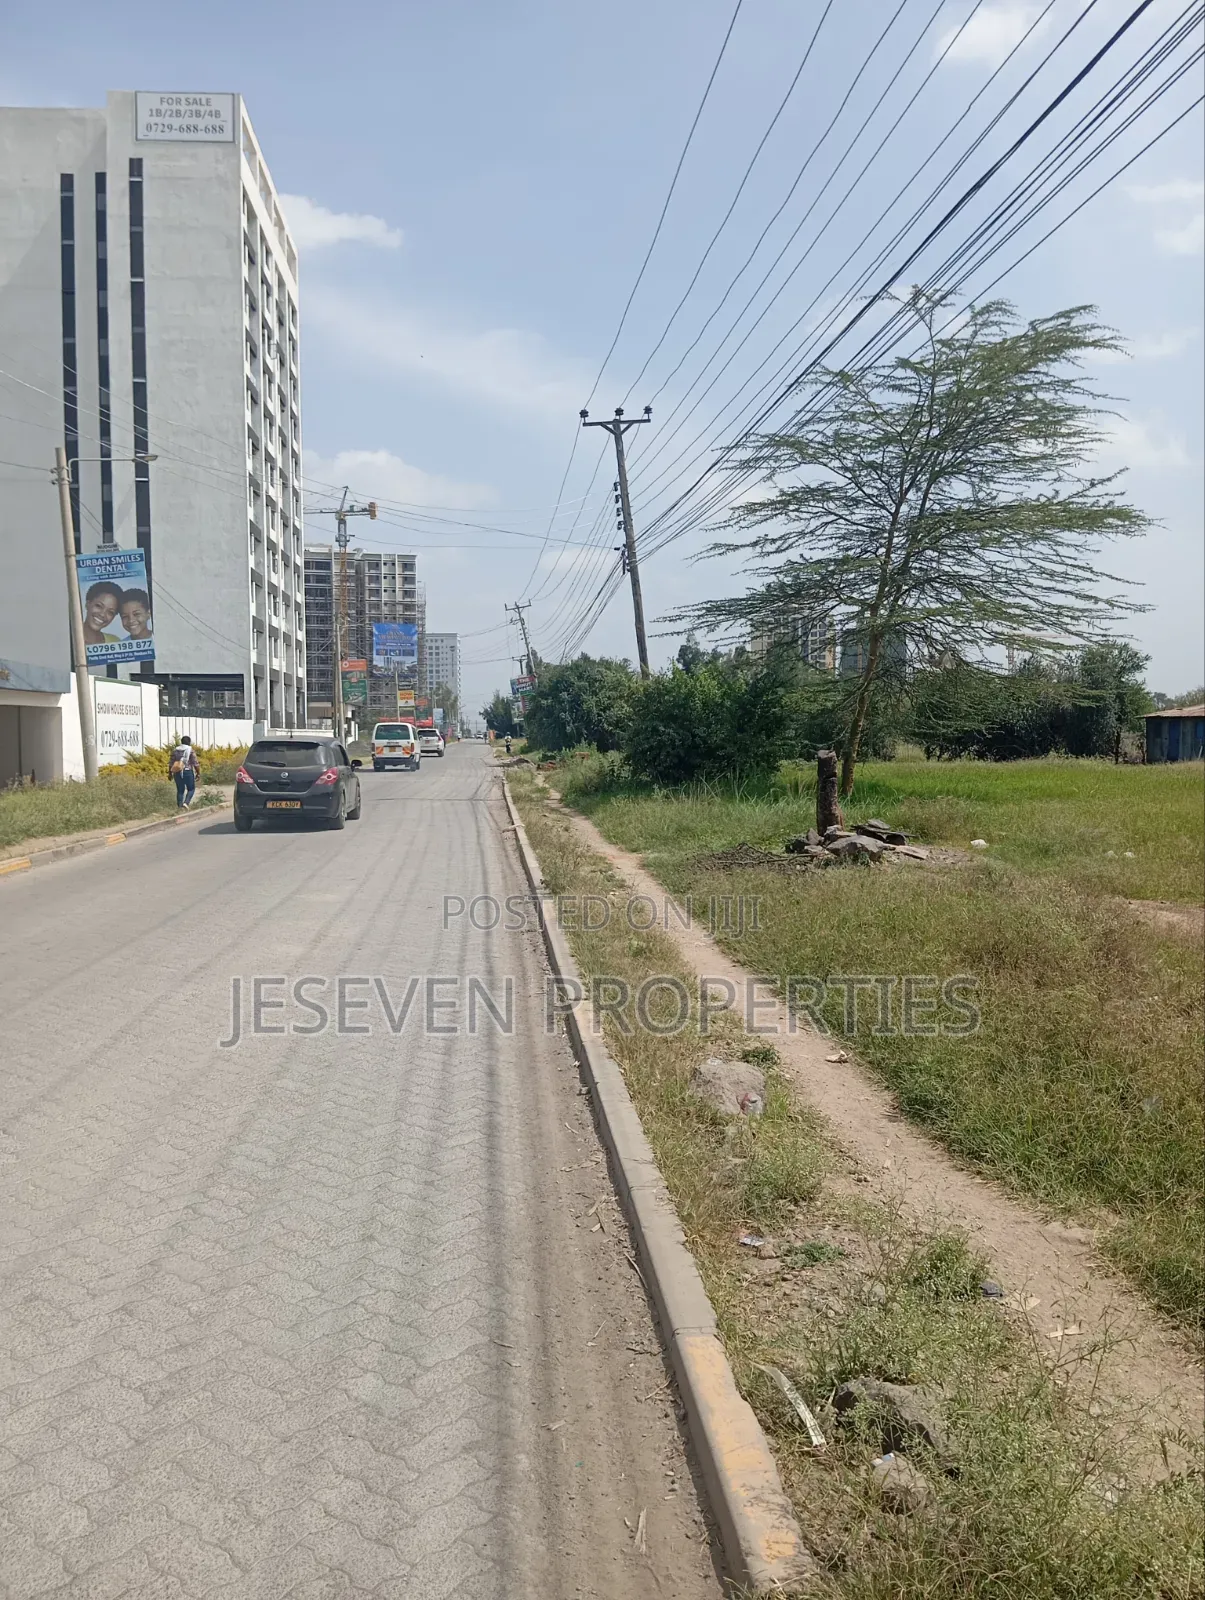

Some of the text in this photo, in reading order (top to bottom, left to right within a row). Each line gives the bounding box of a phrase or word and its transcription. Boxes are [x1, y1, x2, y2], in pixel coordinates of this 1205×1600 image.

[159, 97, 212, 107] FOR SALE
[148, 108, 222, 119] 1B/2B/3B/4B
[145, 122, 225, 135] 0729-688-688
[80, 557, 110, 568] URBAN
[95, 563, 127, 574] DENTAL
[92, 640, 152, 654] 0796 198 877
[97, 703, 110, 715] SHOW
[111, 703, 124, 716] HOUSE
[125, 705, 129, 715] IS
[101, 730, 139, 748] 0729-688-688
